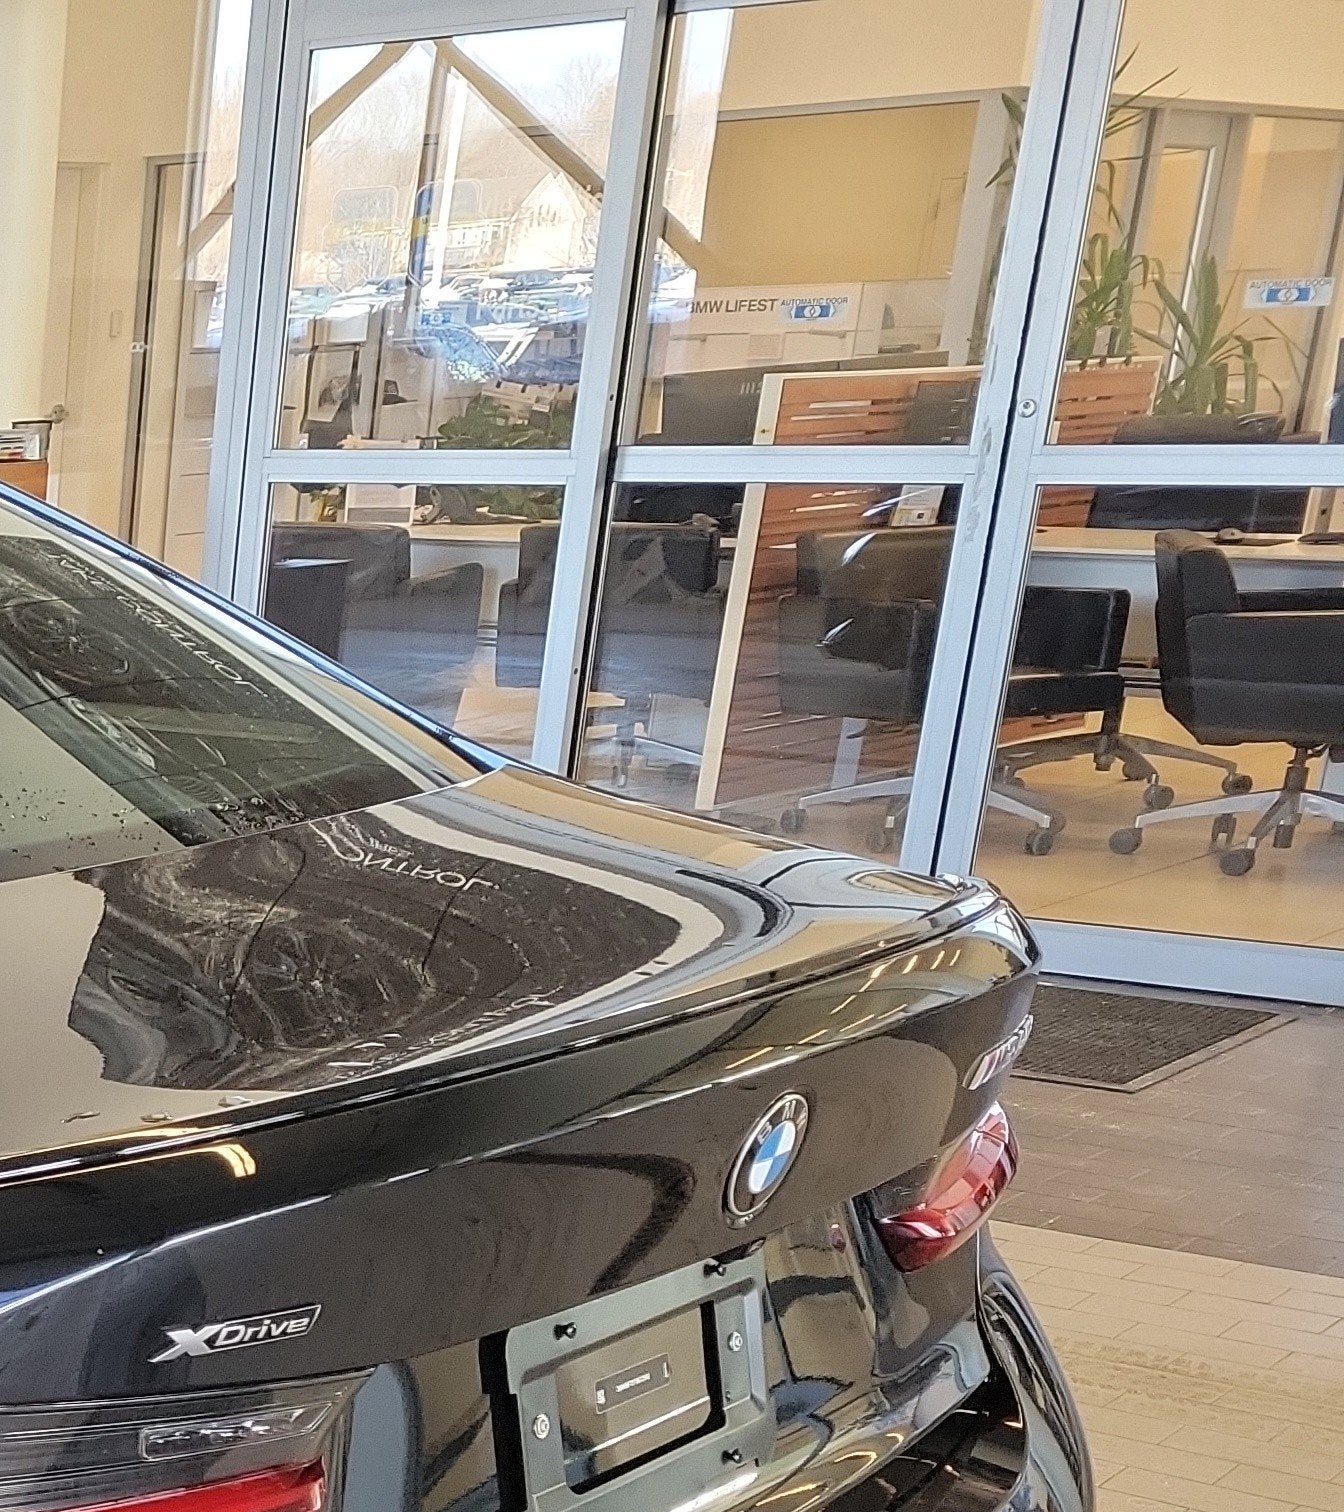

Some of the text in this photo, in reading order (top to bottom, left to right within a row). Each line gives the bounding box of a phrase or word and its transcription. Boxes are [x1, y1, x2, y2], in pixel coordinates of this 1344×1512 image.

[1248, 277, 1333, 290] AUTOMATIC DOOR
[780, 296, 849, 307] AUTOMATIC DOOR
